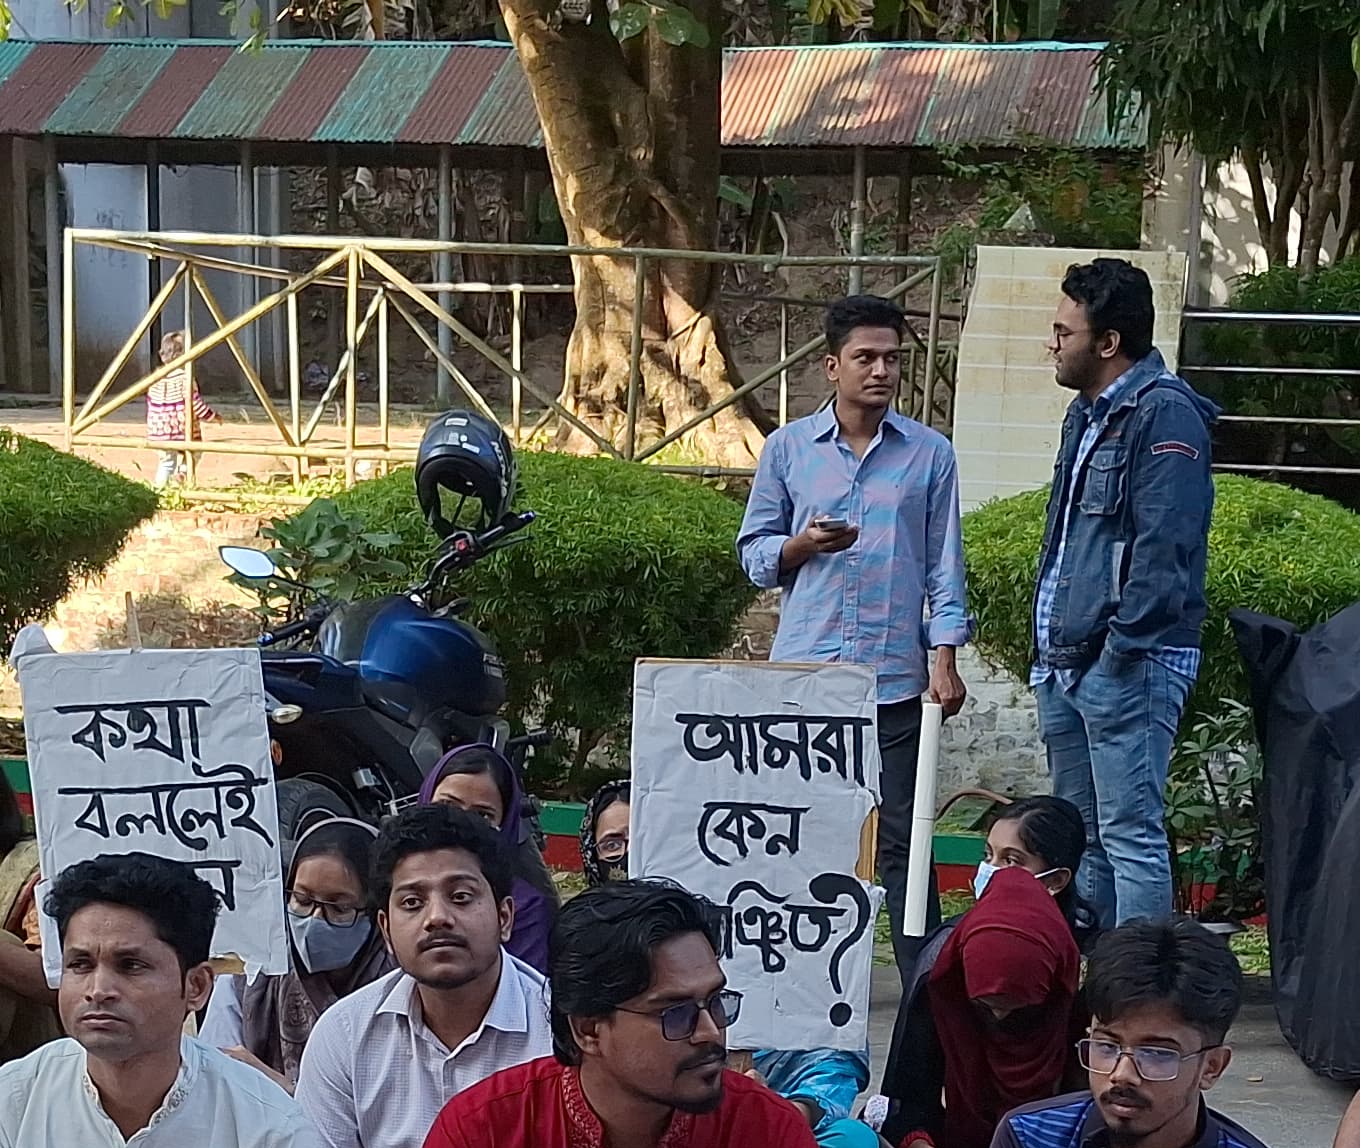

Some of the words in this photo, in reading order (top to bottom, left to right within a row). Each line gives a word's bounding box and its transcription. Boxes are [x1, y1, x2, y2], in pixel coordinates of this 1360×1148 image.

[53, 699, 212, 763] কথা
[675, 712, 873, 787] আমরা
[57, 763, 274, 851] বললেই
[697, 801, 811, 867] কেন
